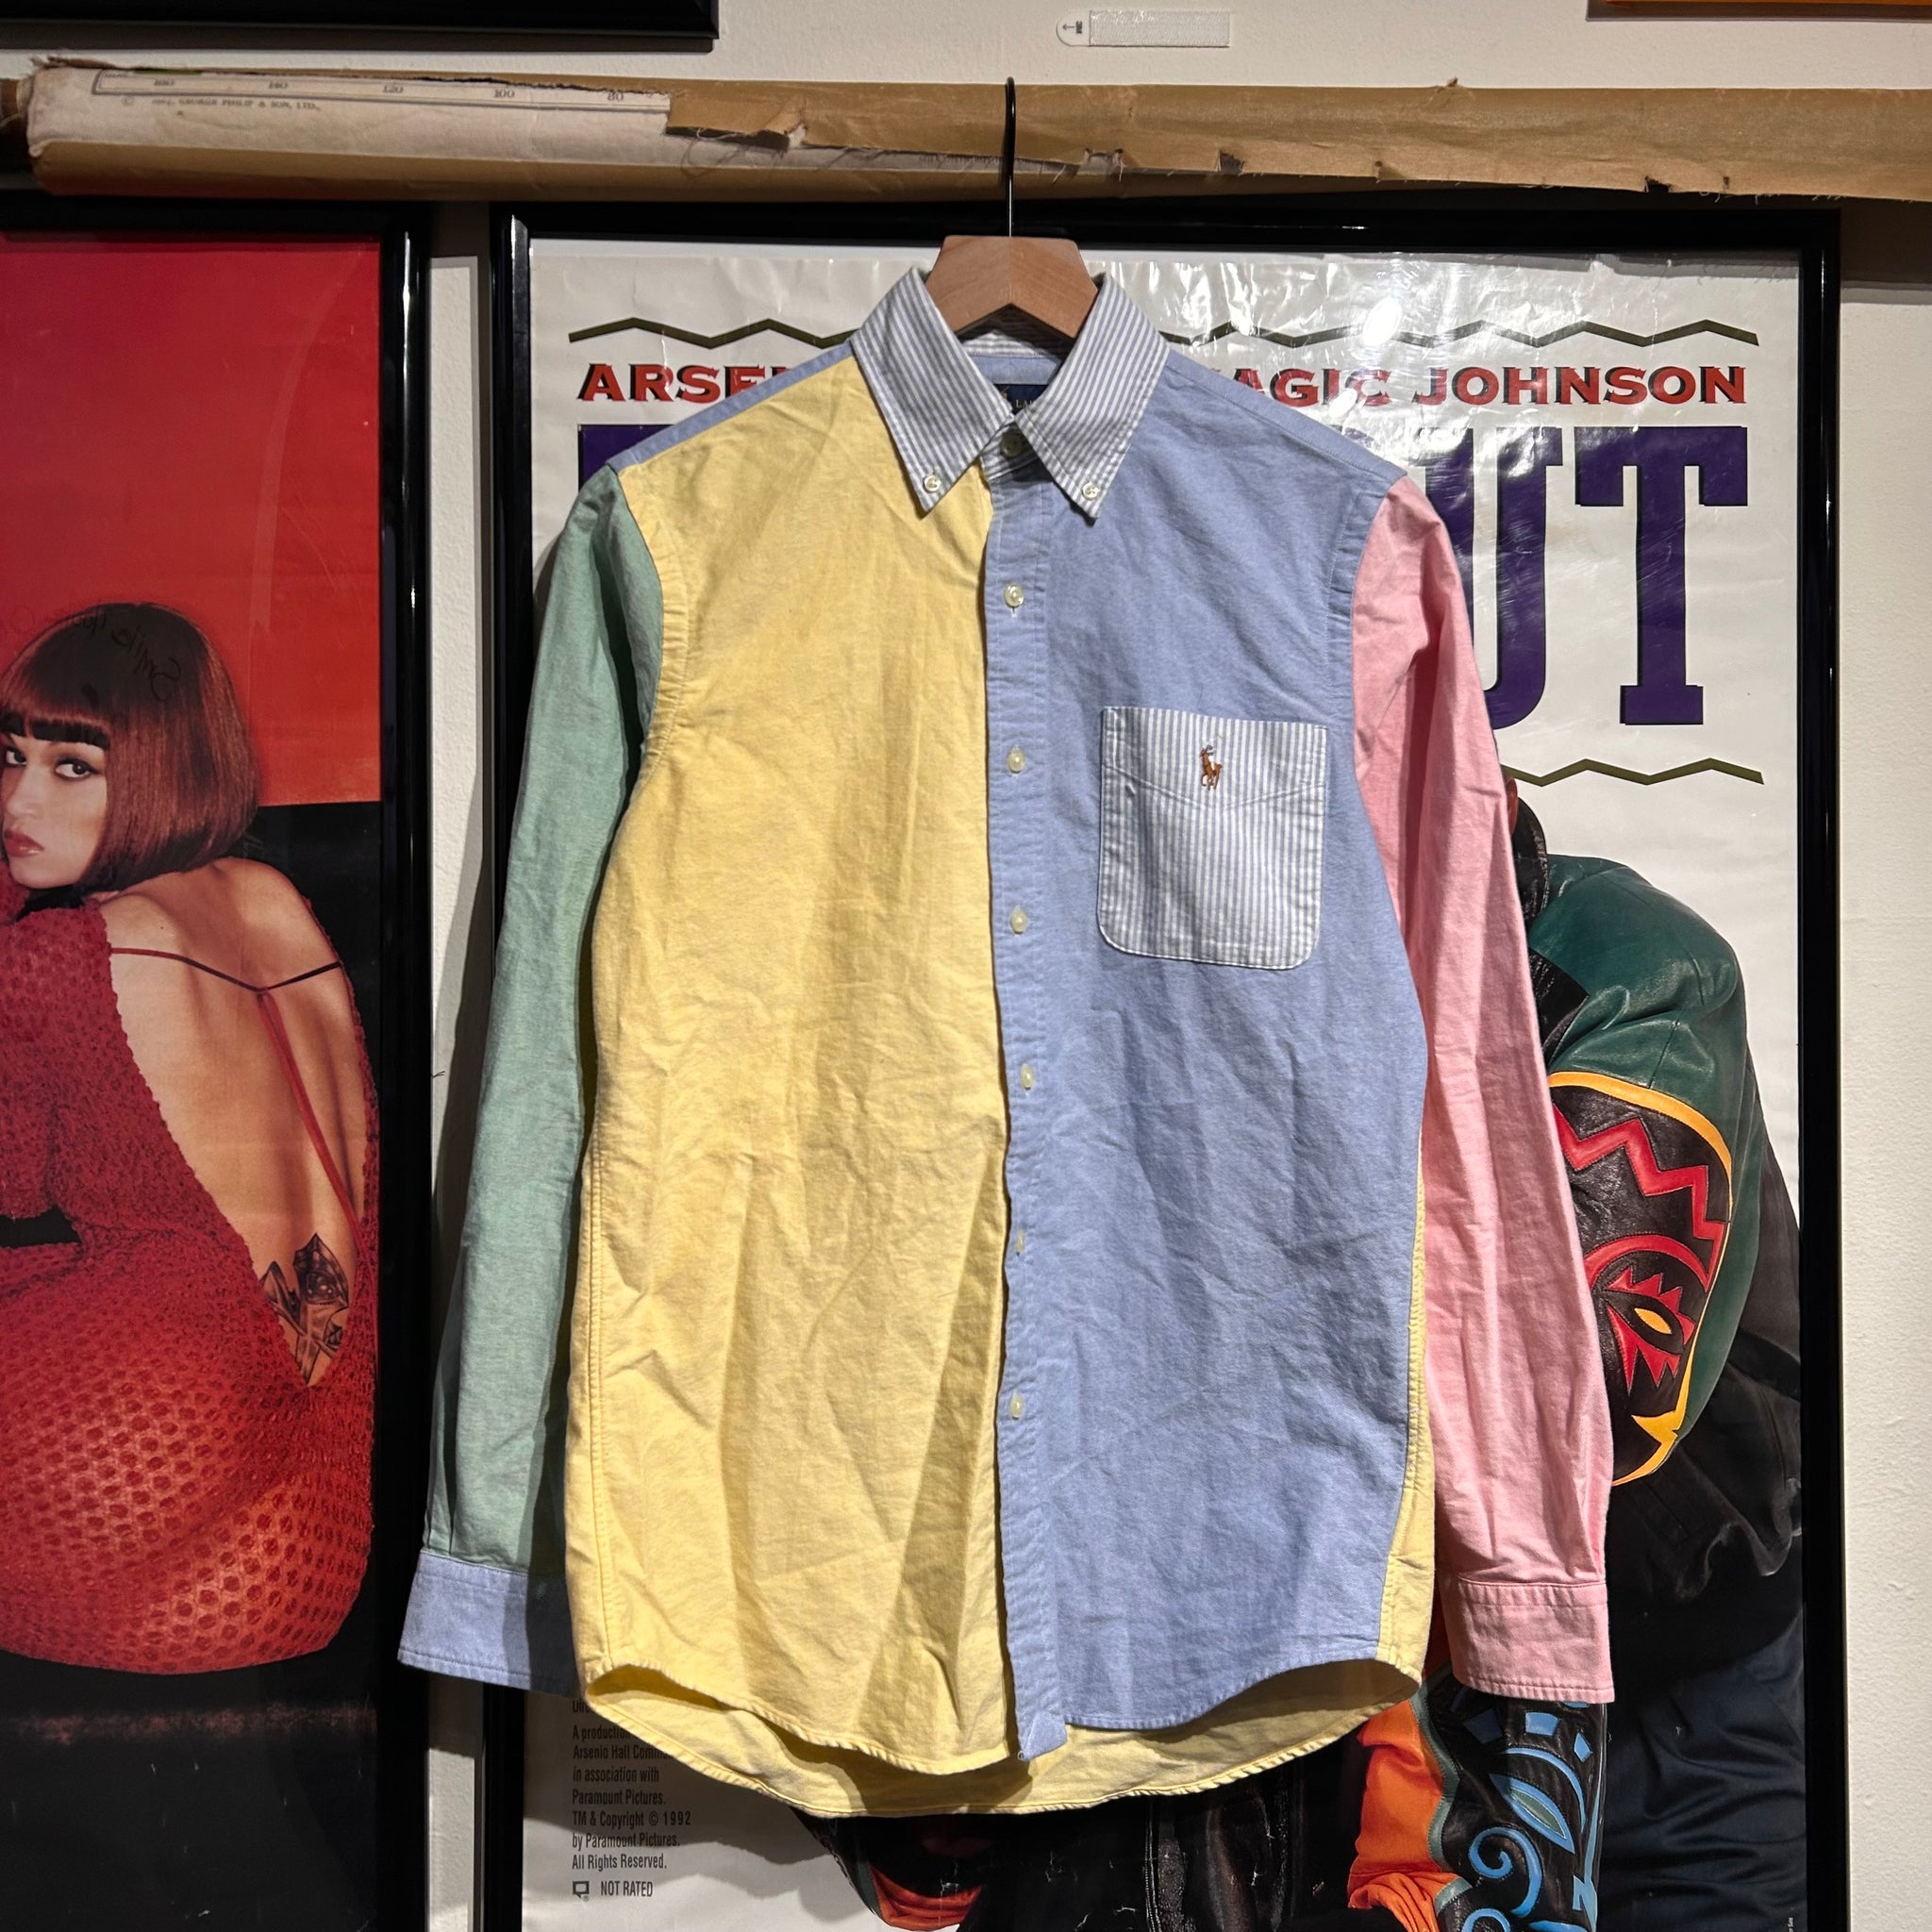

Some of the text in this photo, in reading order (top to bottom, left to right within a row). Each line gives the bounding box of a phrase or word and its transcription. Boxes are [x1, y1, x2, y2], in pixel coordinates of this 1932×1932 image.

[493, 89, 515, 99] 100
[576, 362, 1747, 407] ARSE AGIC JOHNSON
[1328, 425, 1748, 730] UT
[573, 1724, 579, 1740] A
[573, 1744, 608, 1758] Arsenio
[610, 1743, 629, 1758] Hall
[573, 1765, 659, 1783] in association with
[572, 1789, 666, 1806] Paramount Pictures.
[573, 1811, 587, 1826] TM
[590, 1810, 596, 1826] &
[600, 1811, 644, 1830] Copyright
[663, 1810, 691, 1826] 1992
[572, 1831, 680, 1851] by Paramount Pictures.
[572, 1852, 667, 1873] All Rights Reserved.
[600, 1880, 654, 1897] NOT RATED
